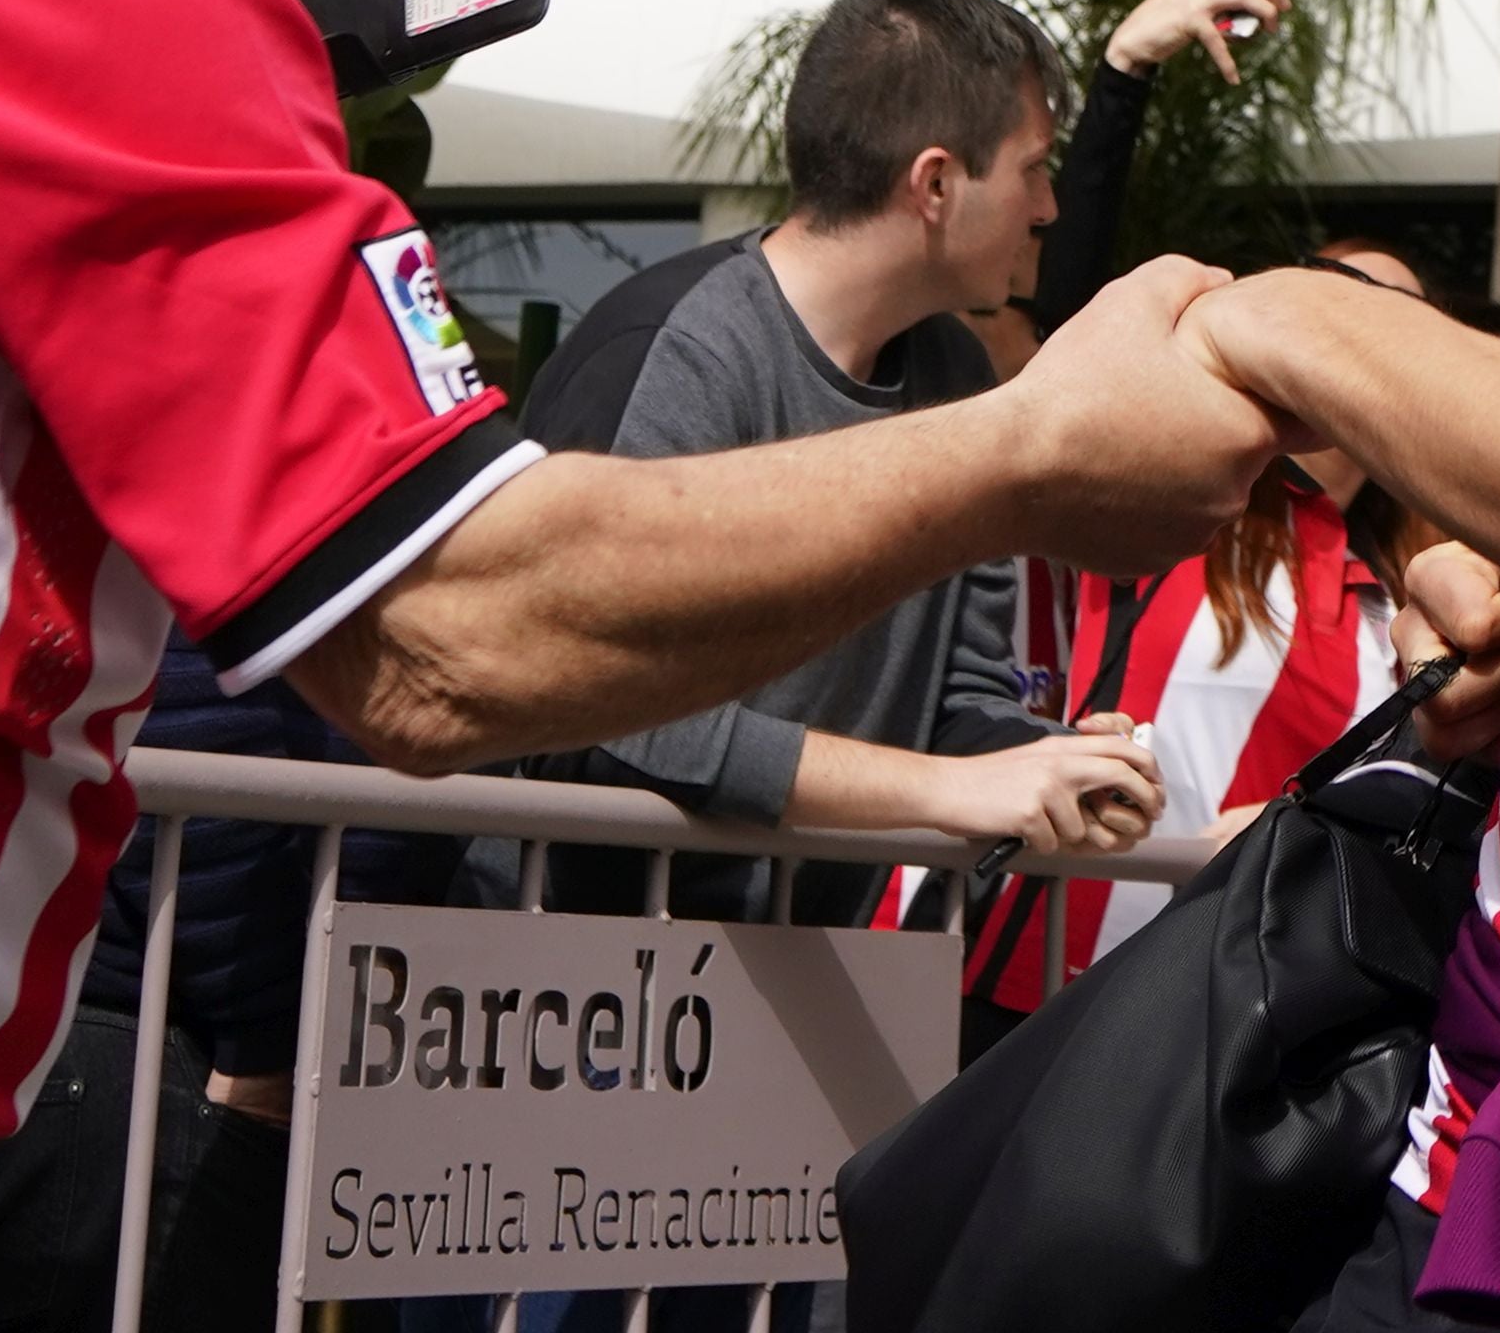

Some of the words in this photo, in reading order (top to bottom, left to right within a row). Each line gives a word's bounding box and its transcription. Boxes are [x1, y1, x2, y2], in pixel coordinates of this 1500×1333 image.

[337, 941, 716, 1093] Barceló
[325, 1162, 529, 1260] Sevilla
[550, 1163, 840, 1253] Renacimie
